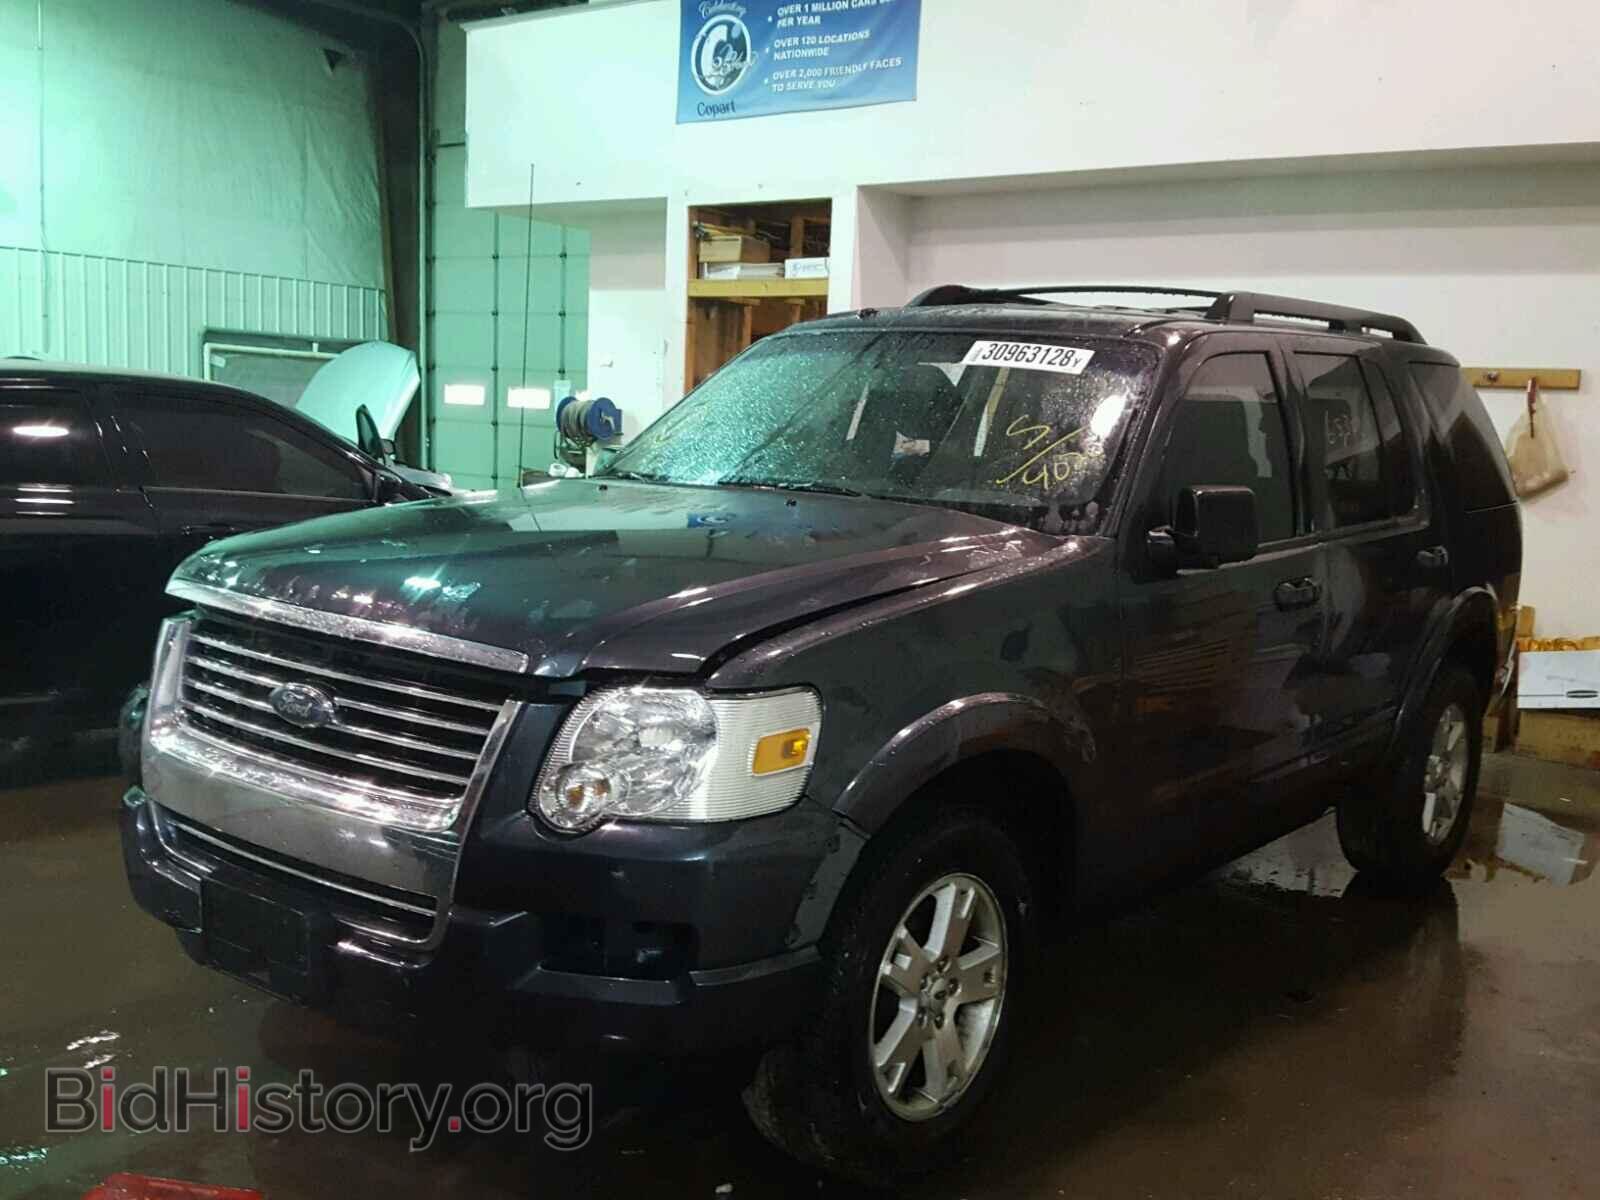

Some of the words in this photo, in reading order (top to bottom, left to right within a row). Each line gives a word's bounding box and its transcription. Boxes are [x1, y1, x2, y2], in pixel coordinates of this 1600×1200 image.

[777, 5, 802, 16] OVER
[804, 3, 809, 12] 1
[811, 0, 849, 13] MILLION
[776, 17, 795, 28] PER
[797, 15, 821, 25] YEAR
[774, 37, 799, 48] OVER
[818, 29, 871, 44] LOCATIONS
[773, 47, 830, 61] NATIONWIDE
[772, 70, 797, 81] OVER
[799, 67, 823, 80] 2,000
[823, 60, 868, 78] FRIENDLY
[869, 56, 903, 69] FACES
[772, 82, 784, 92] TO
[786, 80, 814, 91] SERVE
[817, 78, 837, 89] YOU
[697, 100, 736, 118] Copart
[982, 343, 1076, 367] 30963128
